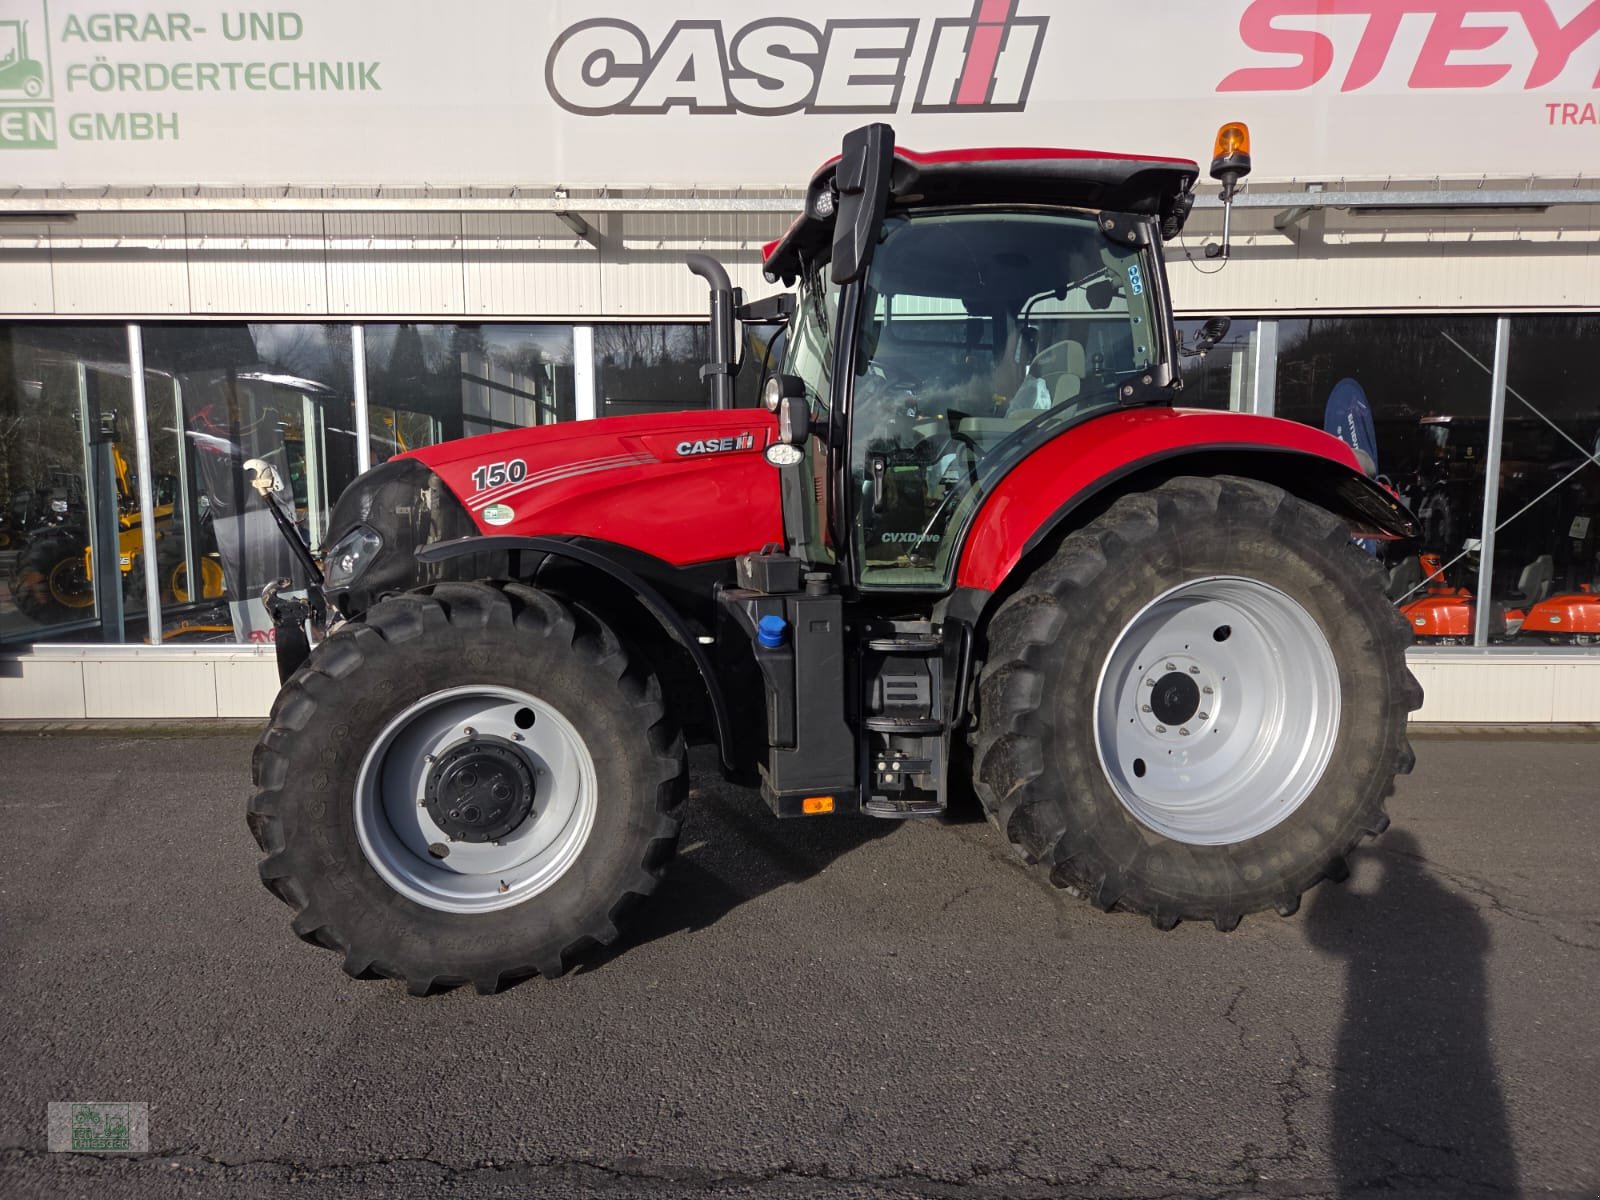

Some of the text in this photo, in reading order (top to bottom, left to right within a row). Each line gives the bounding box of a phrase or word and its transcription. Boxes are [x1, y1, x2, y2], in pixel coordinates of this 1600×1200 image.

[61, 12, 304, 42] AGRAR- UND
[1215, 0, 1600, 93] STEY
[66, 57, 383, 92] FÖRDERTECHNIK
[545, 17, 920, 117] CASE
[69, 112, 180, 141] GMBH
[1545, 102, 1600, 125] TRA
[675, 437, 734, 456] CASE
[471, 458, 527, 492] 150
